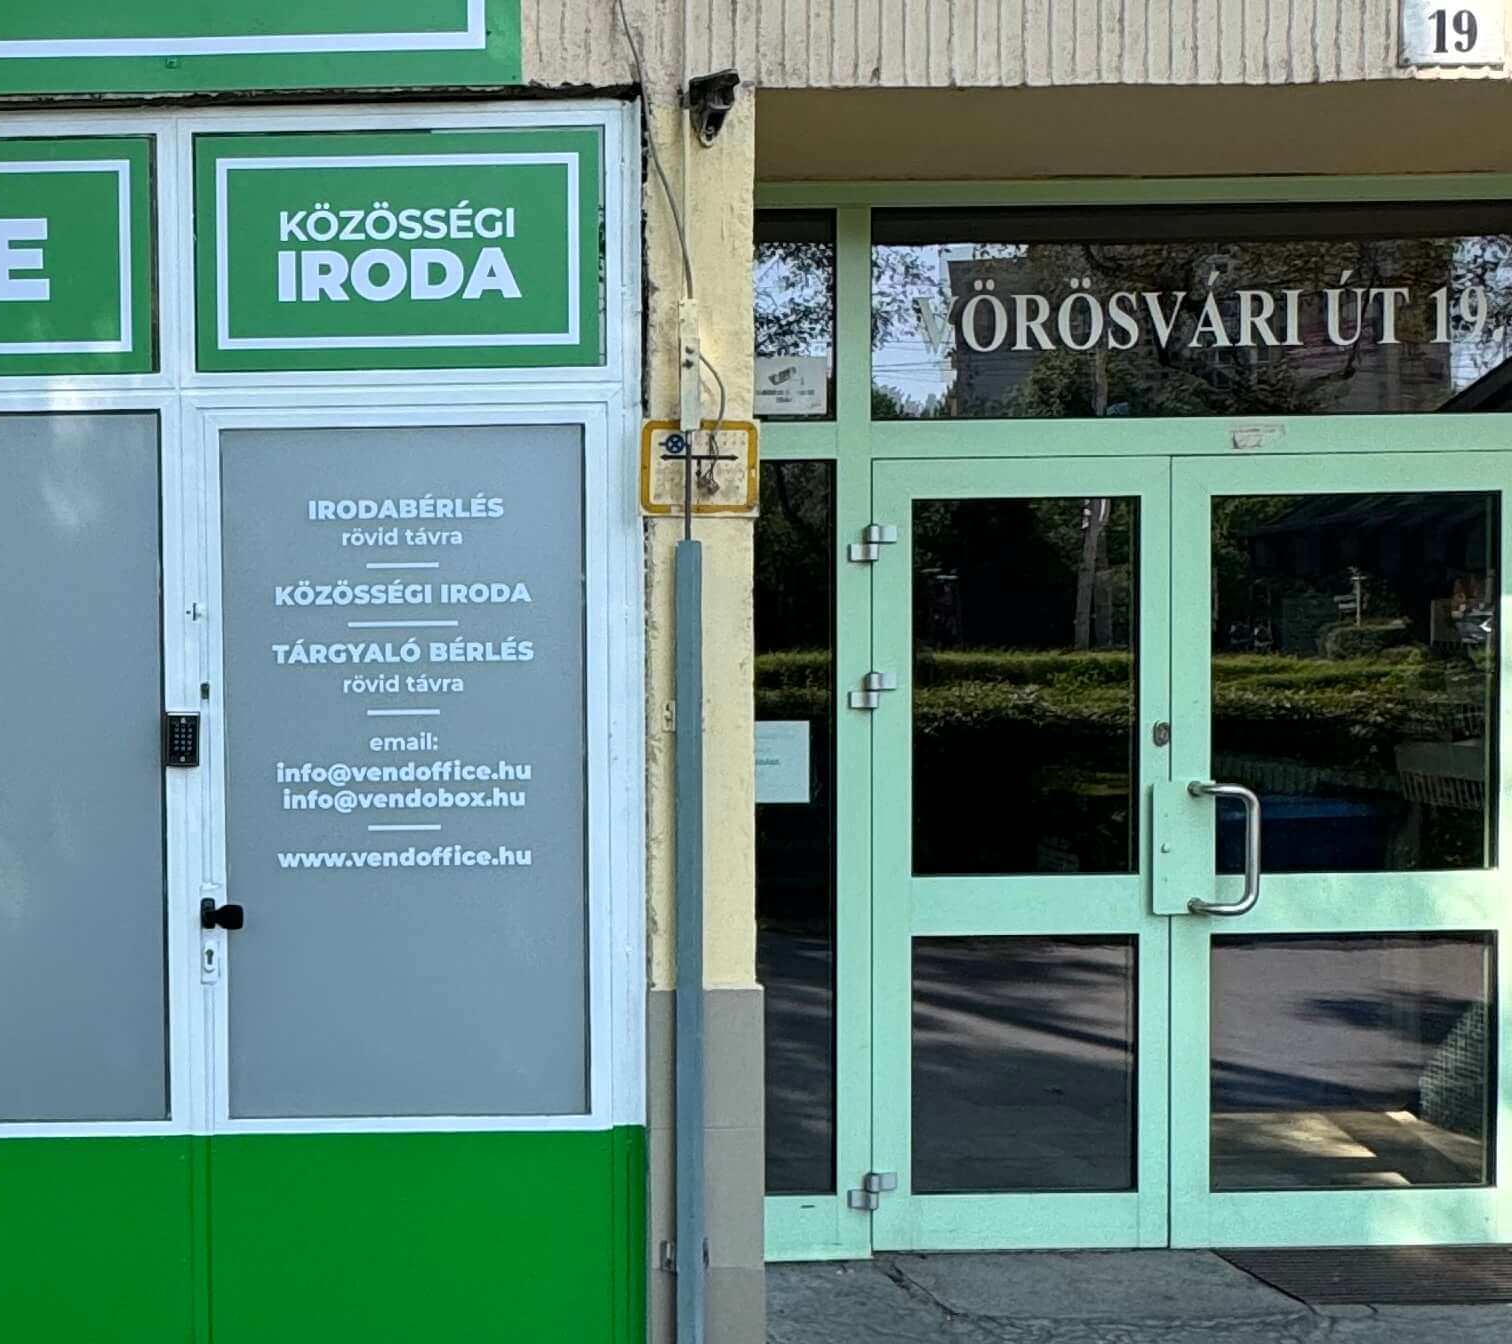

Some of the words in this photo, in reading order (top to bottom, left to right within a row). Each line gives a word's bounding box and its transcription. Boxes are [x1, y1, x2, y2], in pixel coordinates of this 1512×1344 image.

[1428, 9, 1478, 54] 19
[279, 199, 515, 242] KÖZÖSSÉGI
[277, 246, 523, 302] IRODA
[913, 271, 1304, 354] VÖRÖSVÁRI
[1322, 269, 1410, 347] ÚT
[308, 494, 505, 520] IRODABÉRLÉS
[341, 526, 399, 546] rövid
[404, 527, 463, 546] távra
[275, 578, 433, 606] KÖZÖSSÉGI
[440, 582, 533, 604] IRODA
[271, 637, 421, 665] TÁRGYALÓ
[429, 636, 535, 662] BÉRLÉS
[343, 674, 400, 694] rövid
[405, 673, 464, 693] távra
[369, 732, 439, 752] email:
[276, 759, 532, 786] info@vendoffice.hu
[283, 788, 526, 813] info@vendobox.hu
[277, 845, 532, 868] www.vendoffice.hu
